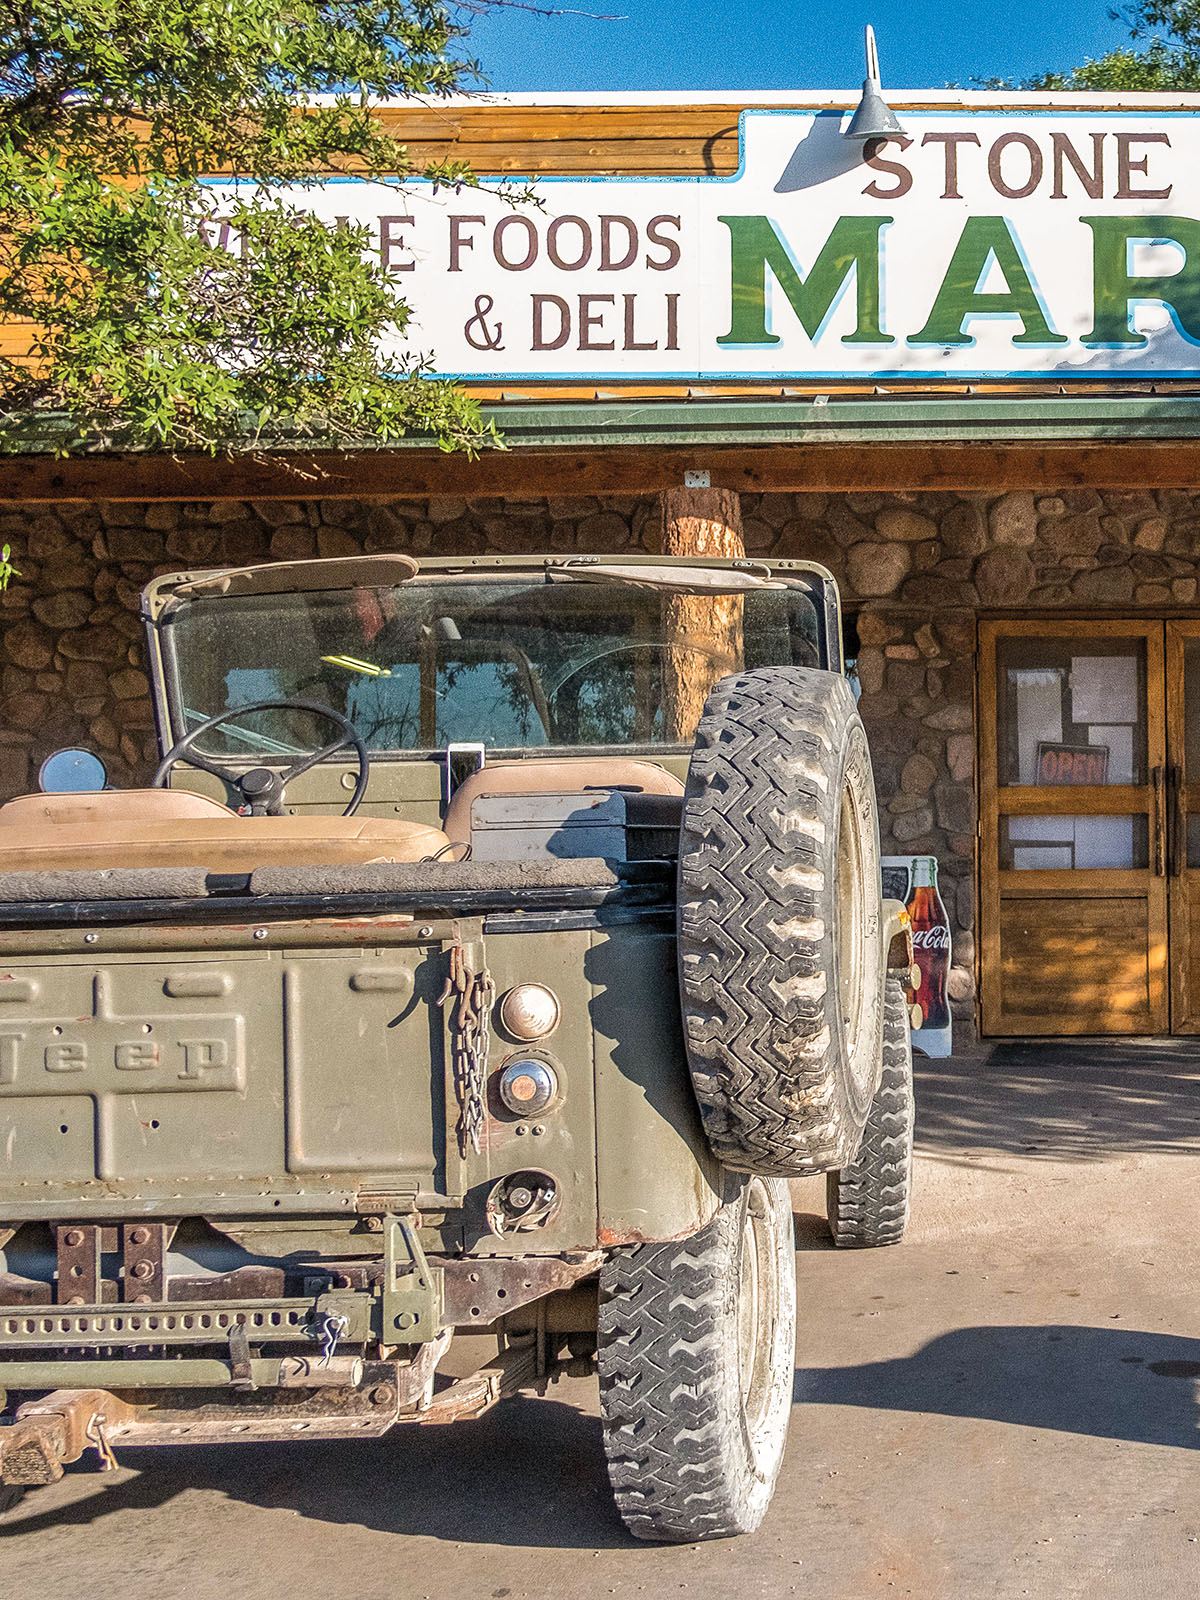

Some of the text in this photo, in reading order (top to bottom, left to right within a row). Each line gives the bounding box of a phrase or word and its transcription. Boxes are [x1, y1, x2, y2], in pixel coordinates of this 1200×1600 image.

[861, 132, 1172, 199] STONE
[448, 214, 681, 271] FOODS
[464, 293, 680, 351] & DELI
[1041, 750, 1104, 783] OPEN
